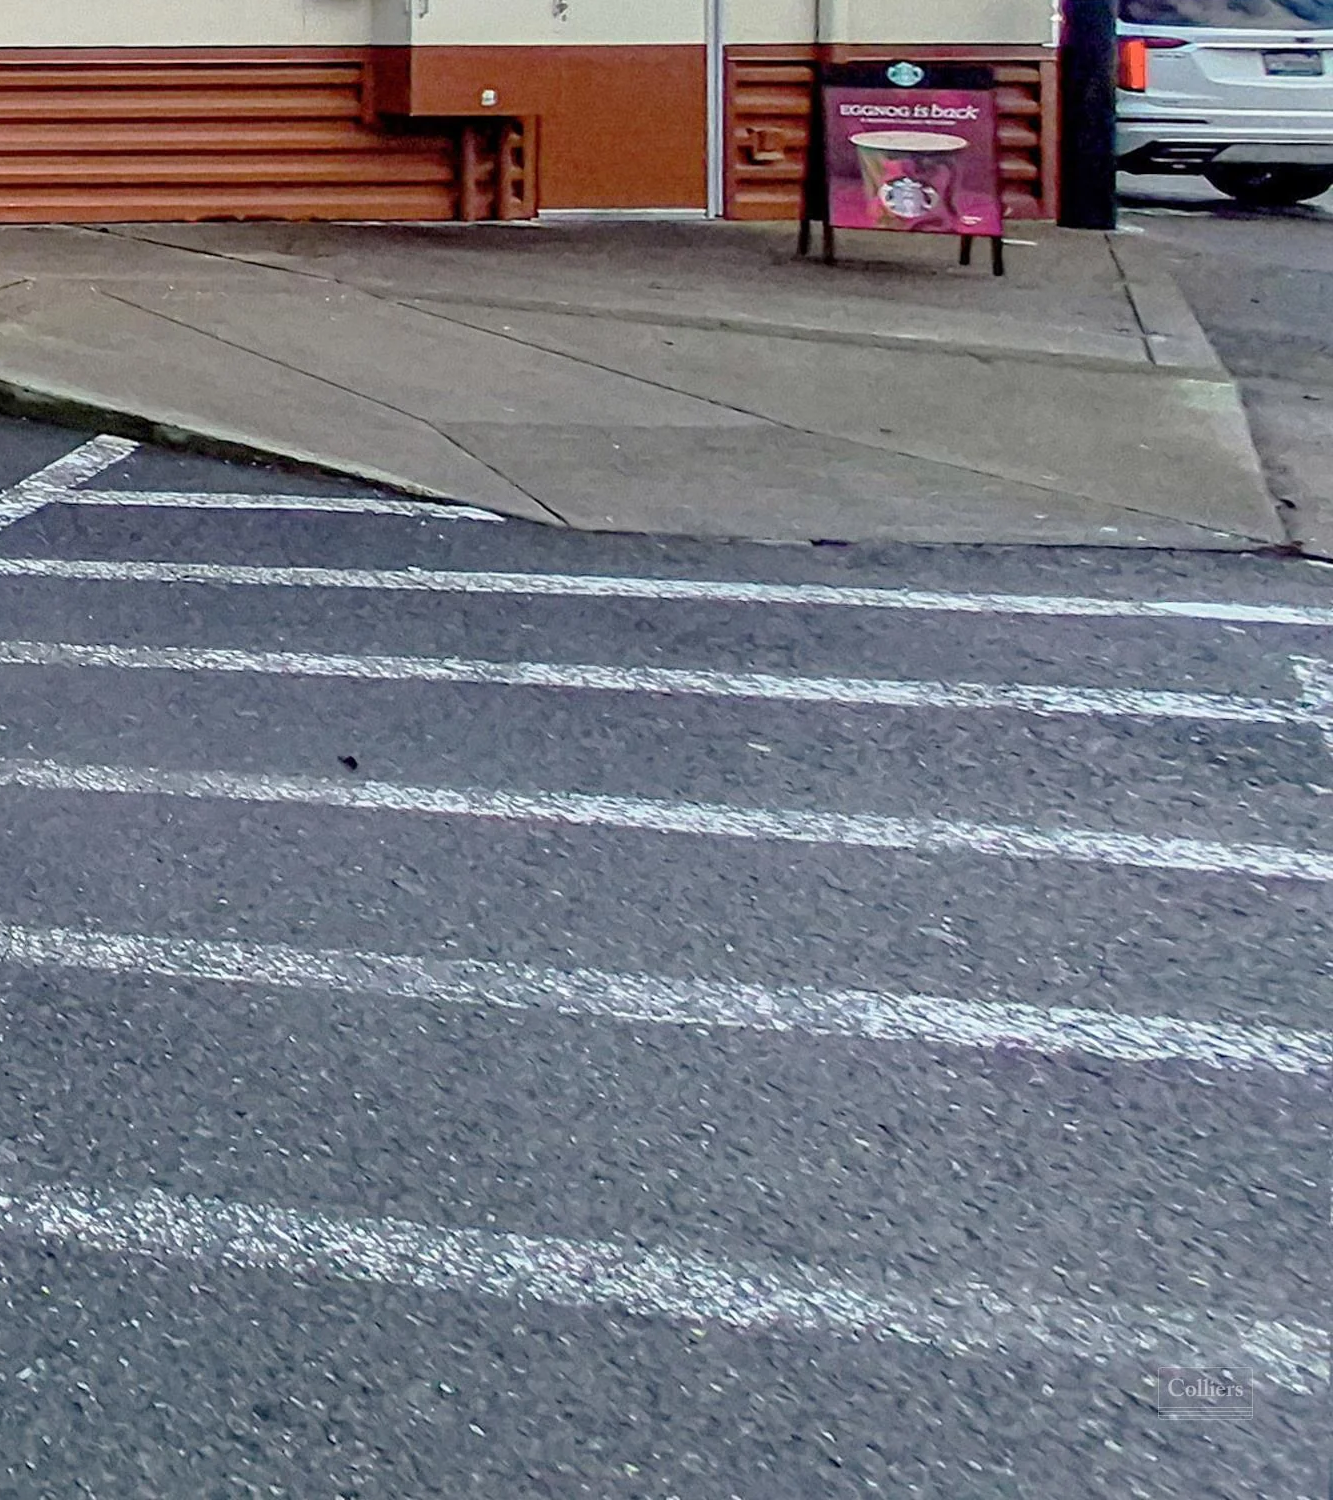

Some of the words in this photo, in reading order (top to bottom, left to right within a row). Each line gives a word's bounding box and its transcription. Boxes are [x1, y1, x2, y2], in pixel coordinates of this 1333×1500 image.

[840, 104, 910, 117] EGGNOG
[914, 104, 929, 117] is
[931, 104, 980, 120] back
